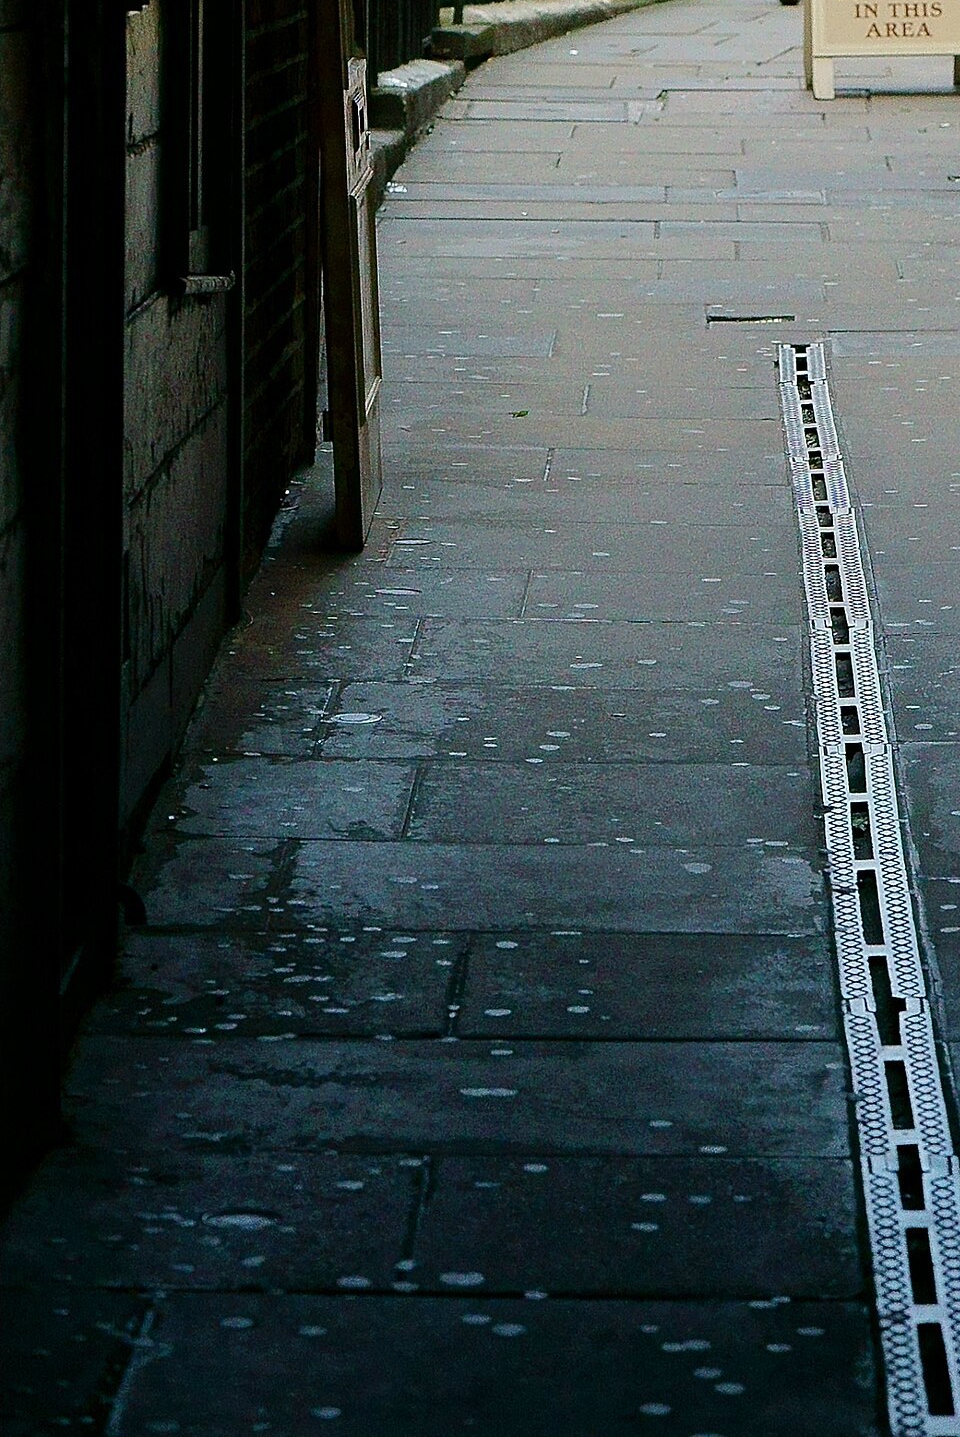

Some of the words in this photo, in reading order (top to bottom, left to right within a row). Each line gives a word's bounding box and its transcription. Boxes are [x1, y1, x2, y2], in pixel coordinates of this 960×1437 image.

[854, 3, 878, 19] IN
[889, 1, 943, 18] THIS
[865, 22, 933, 38] AREA
